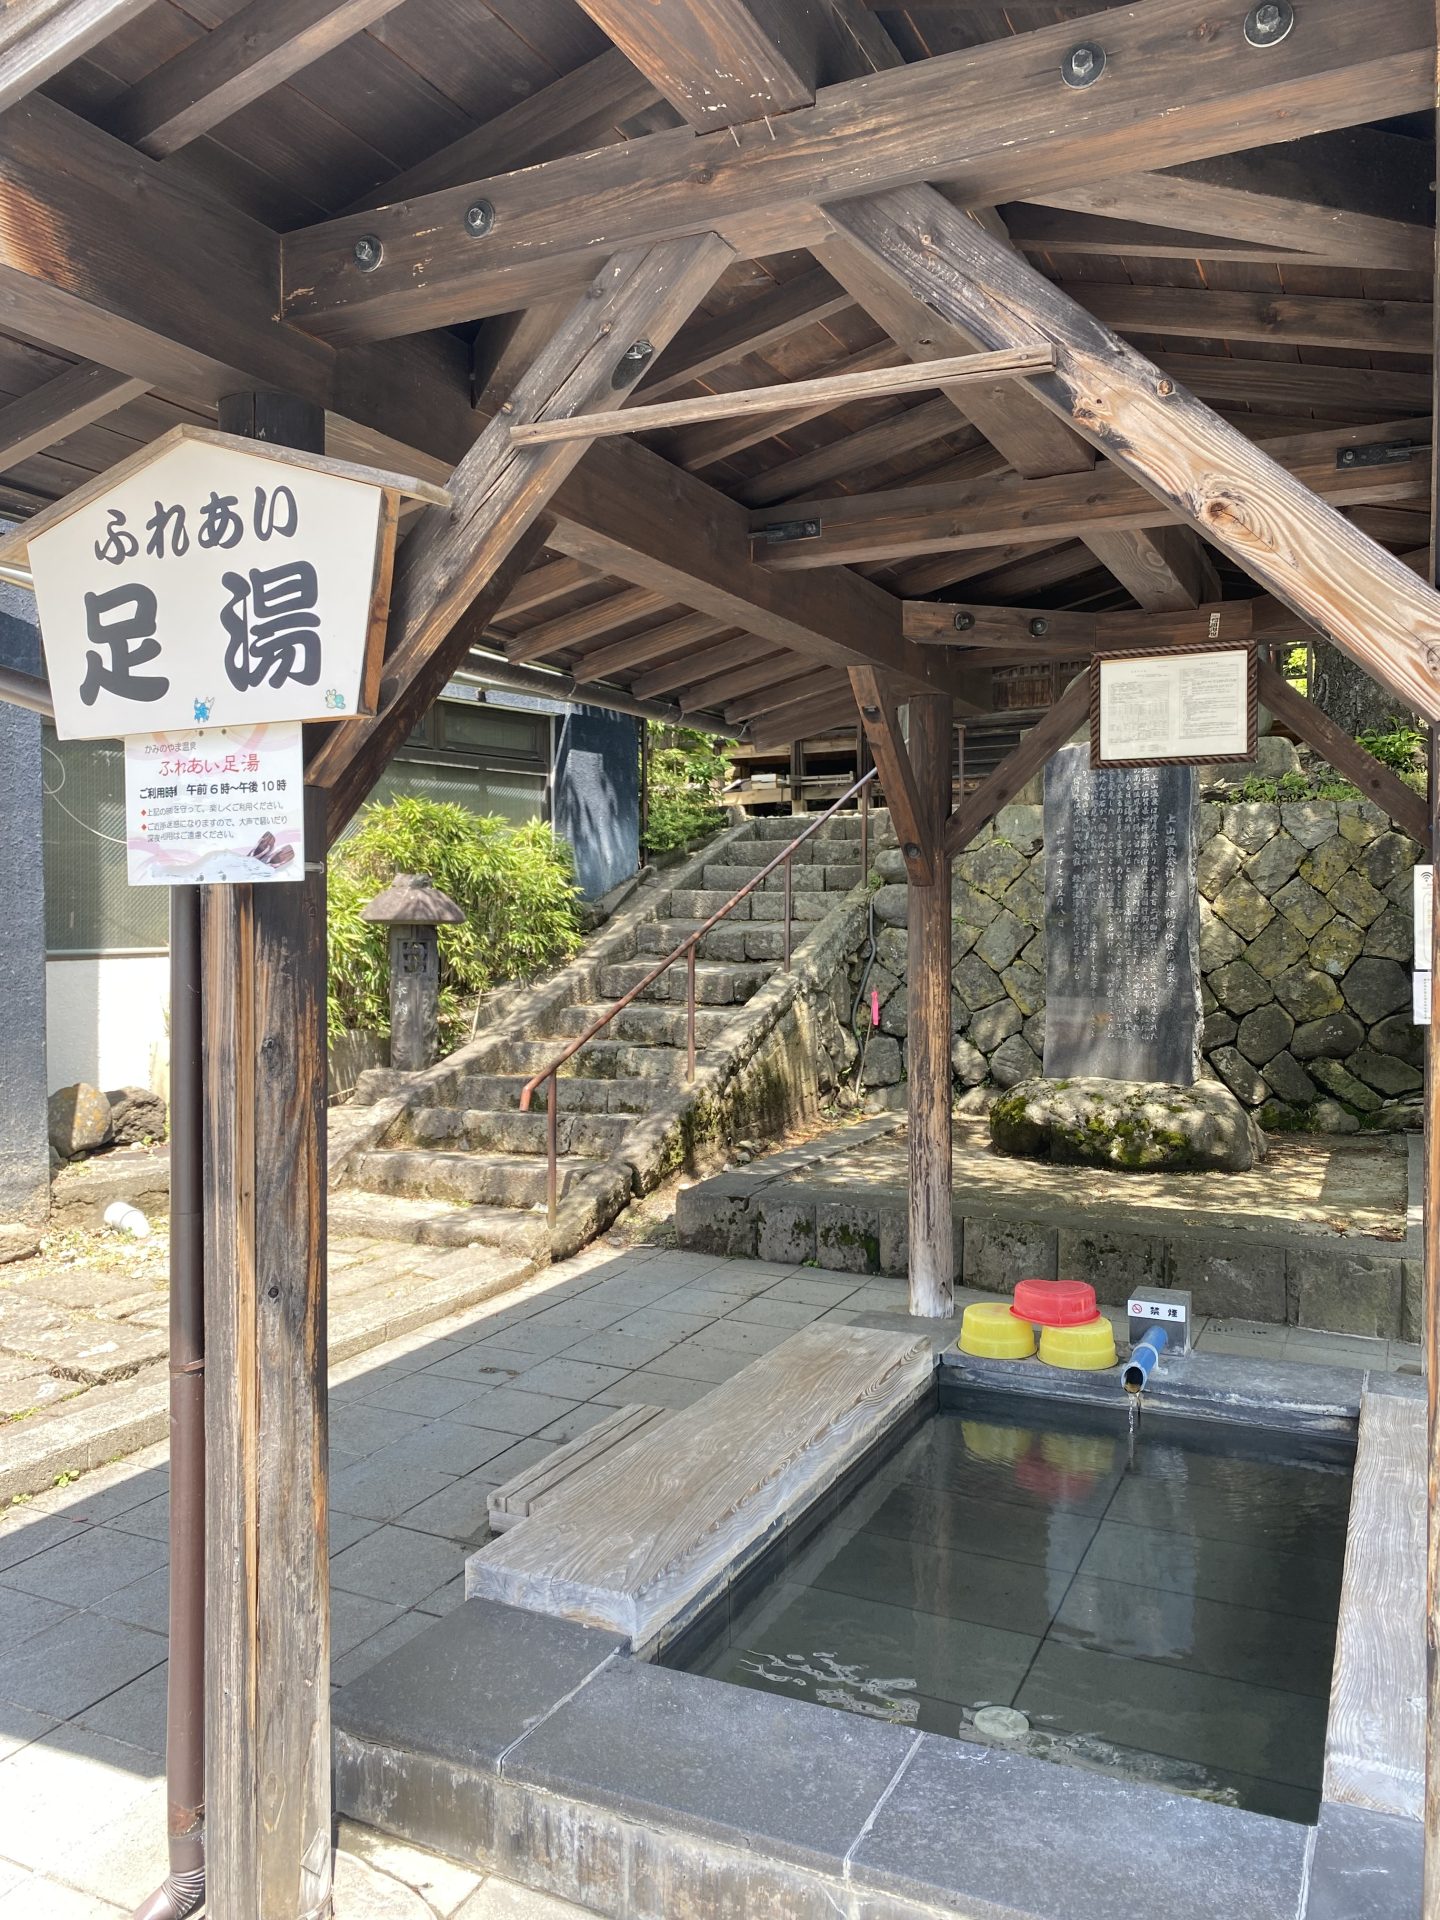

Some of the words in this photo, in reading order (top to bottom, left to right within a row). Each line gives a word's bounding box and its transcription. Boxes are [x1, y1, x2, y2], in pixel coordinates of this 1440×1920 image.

[95, 486, 298, 565] ふれあい
[79, 560, 322, 706] 足湯
[145, 742, 197, 754] かみのやま温泉
[158, 753, 260, 777] ふれあい足湯
[1150, 1306, 1178, 1317] 禁煙
